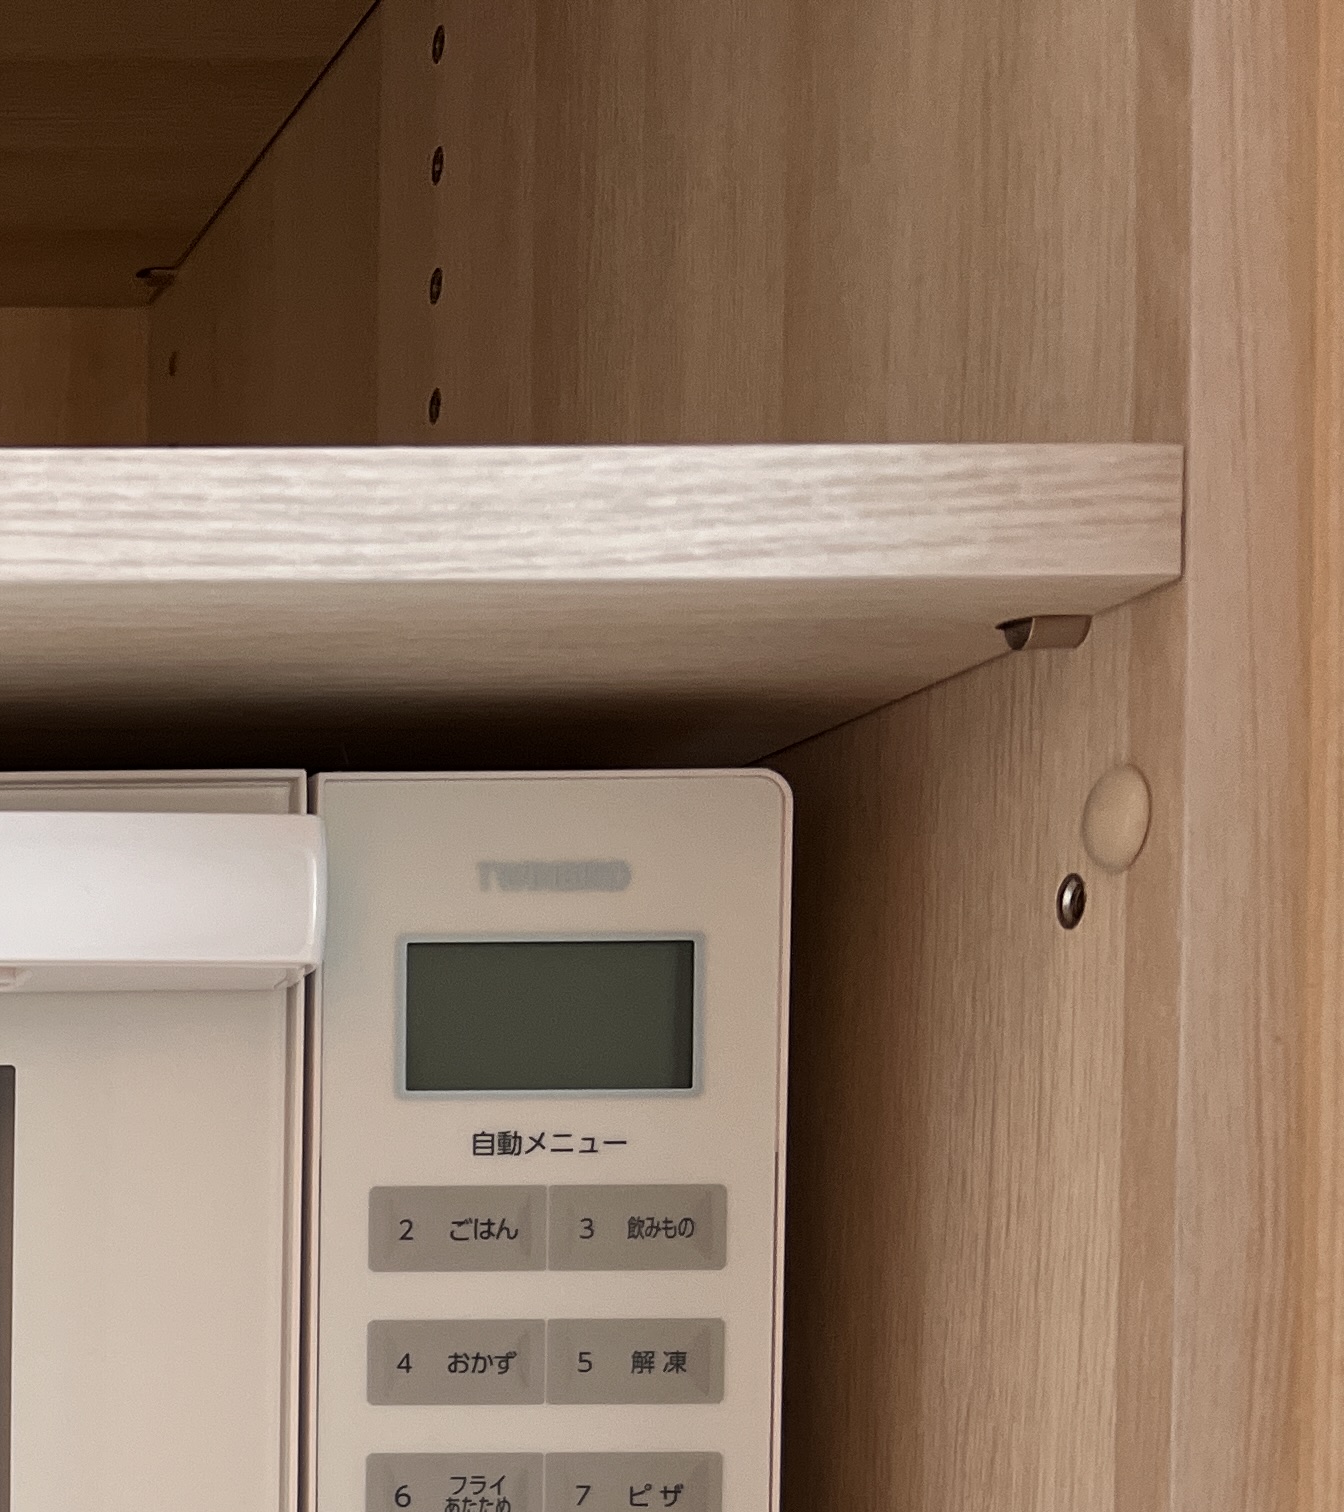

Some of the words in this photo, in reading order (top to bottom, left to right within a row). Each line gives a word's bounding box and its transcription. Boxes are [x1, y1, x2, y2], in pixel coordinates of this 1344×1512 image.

[472, 1129, 628, 1157] 自動メニュー
[398, 1218, 414, 1241] 2
[449, 1217, 519, 1242] ごはん
[579, 1217, 595, 1240] 3
[627, 1216, 696, 1240] 飲みもの
[396, 1352, 413, 1374] 4
[447, 1350, 518, 1375] おかず
[577, 1351, 593, 1373] 5
[630, 1349, 688, 1375] 解凍
[394, 1484, 412, 1508] 6
[449, 1475, 507, 1496] フライ
[575, 1484, 592, 1506] 7
[629, 1483, 685, 1508] ピザ
